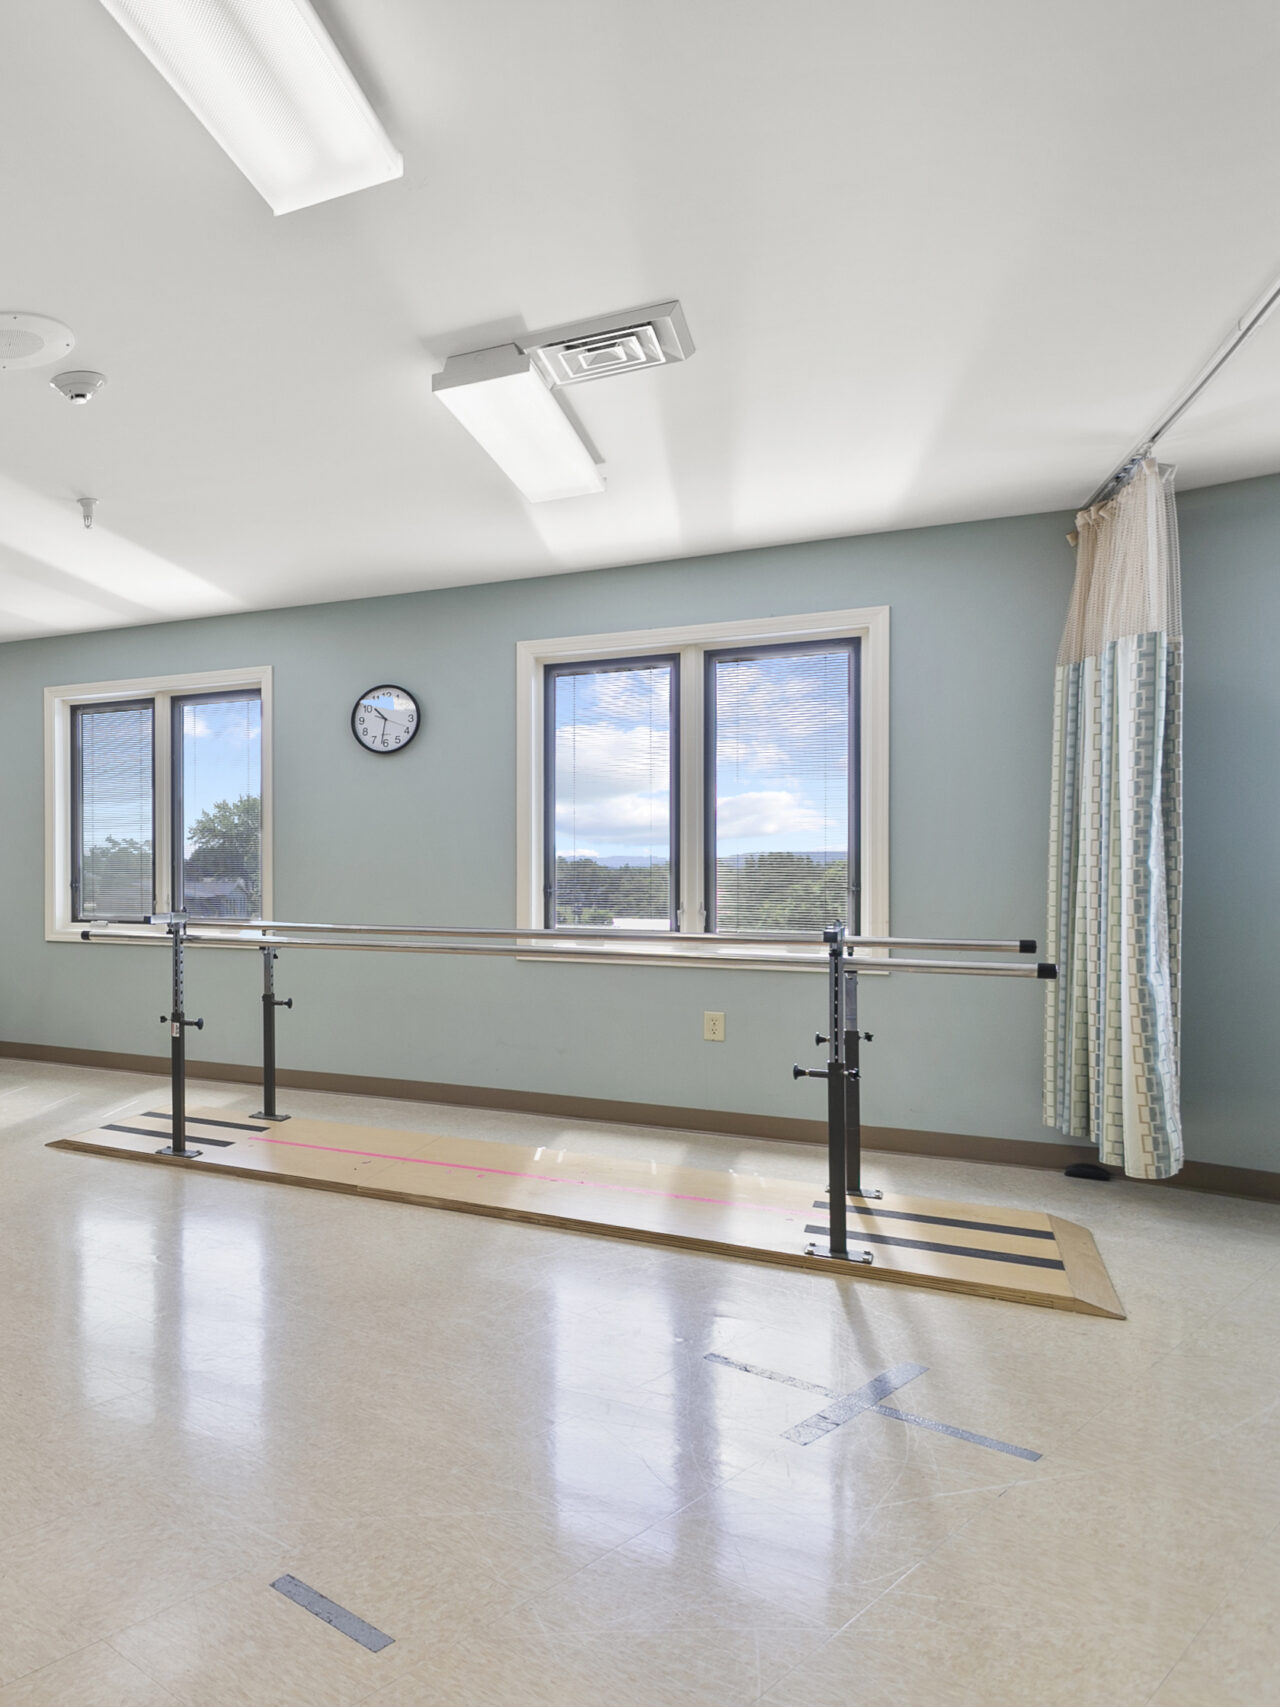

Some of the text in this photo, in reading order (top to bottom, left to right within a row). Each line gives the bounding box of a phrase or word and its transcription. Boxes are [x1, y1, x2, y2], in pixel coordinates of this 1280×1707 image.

[363, 705, 373, 713] 10
[358, 717, 365, 725] 9
[407, 714, 414, 722] 3
[362, 727, 368, 736] 8
[404, 726, 410, 734] 4
[371, 735, 377, 744] 7
[382, 738, 389, 747] 6
[395, 735, 401, 744] 5
